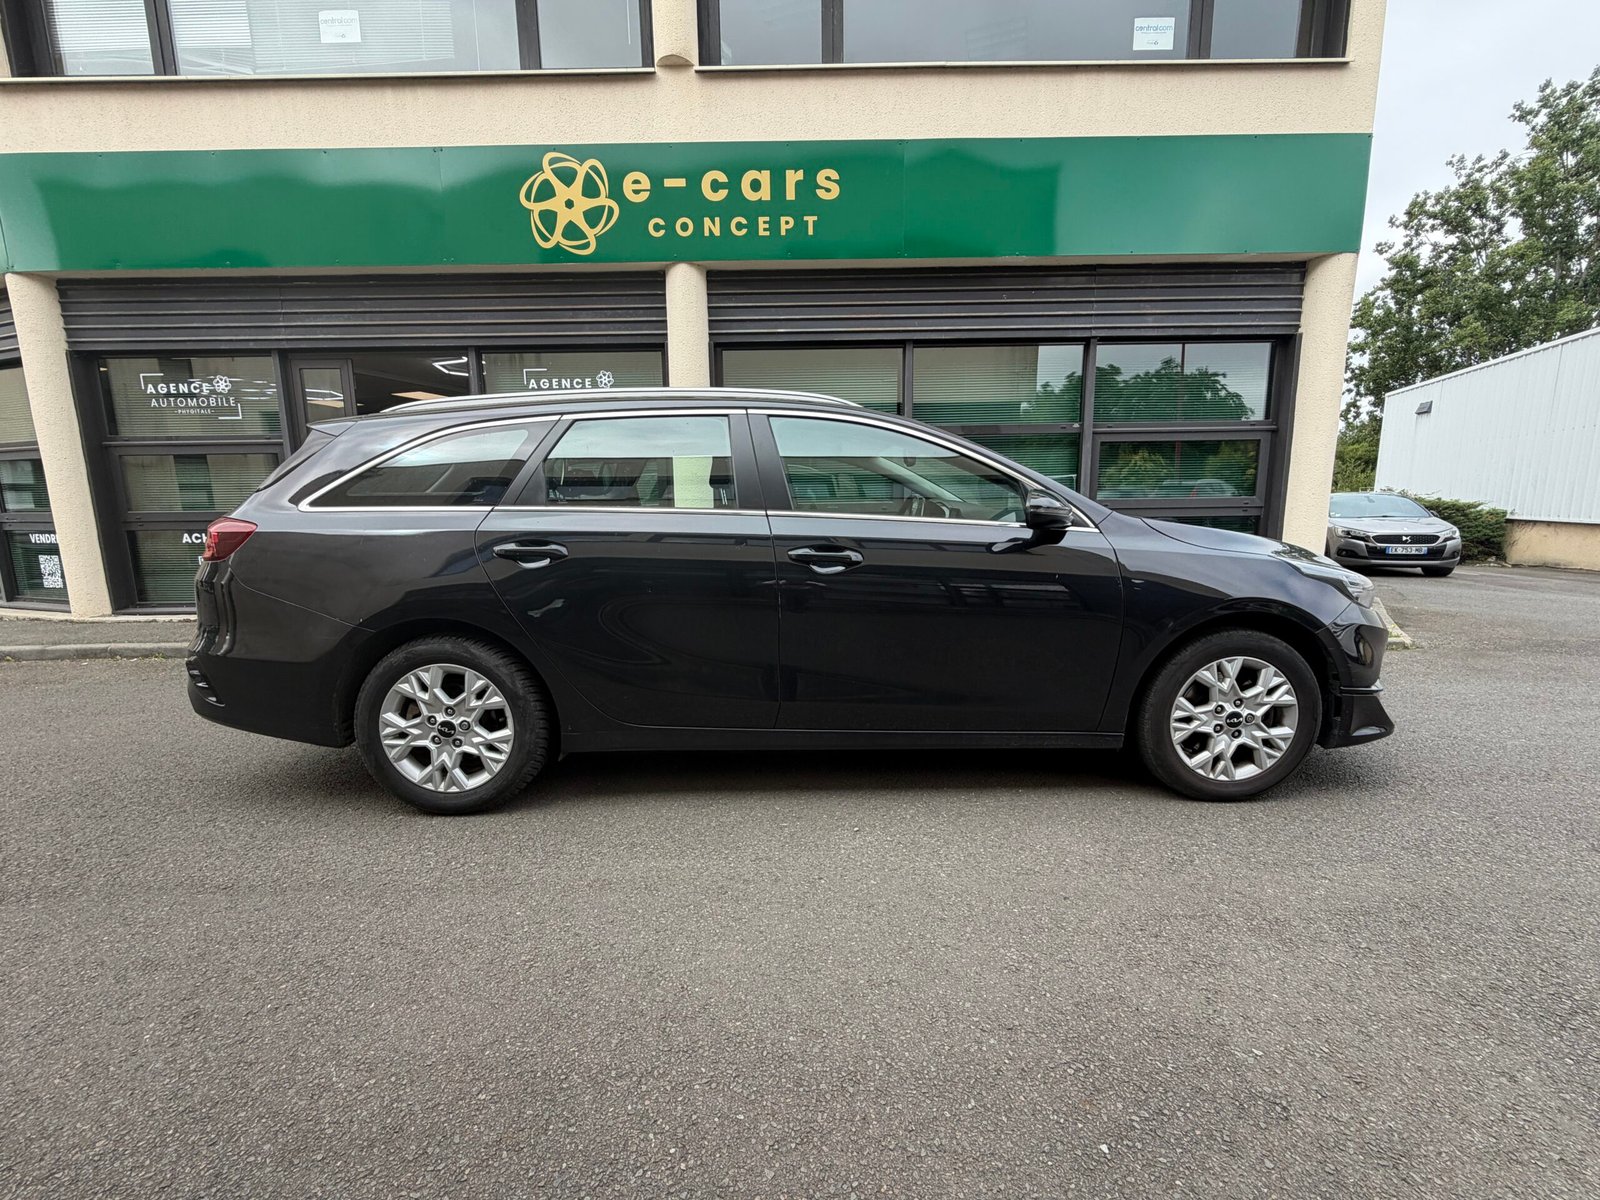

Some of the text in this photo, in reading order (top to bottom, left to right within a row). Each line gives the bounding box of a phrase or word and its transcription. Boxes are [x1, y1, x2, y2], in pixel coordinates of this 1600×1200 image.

[622, 168, 841, 203] e-cars
[648, 215, 818, 237] CONCEPT
[146, 383, 210, 394] AGENCE
[528, 378, 592, 389] AGENCE
[150, 397, 236, 407] AUTOMOBILE
